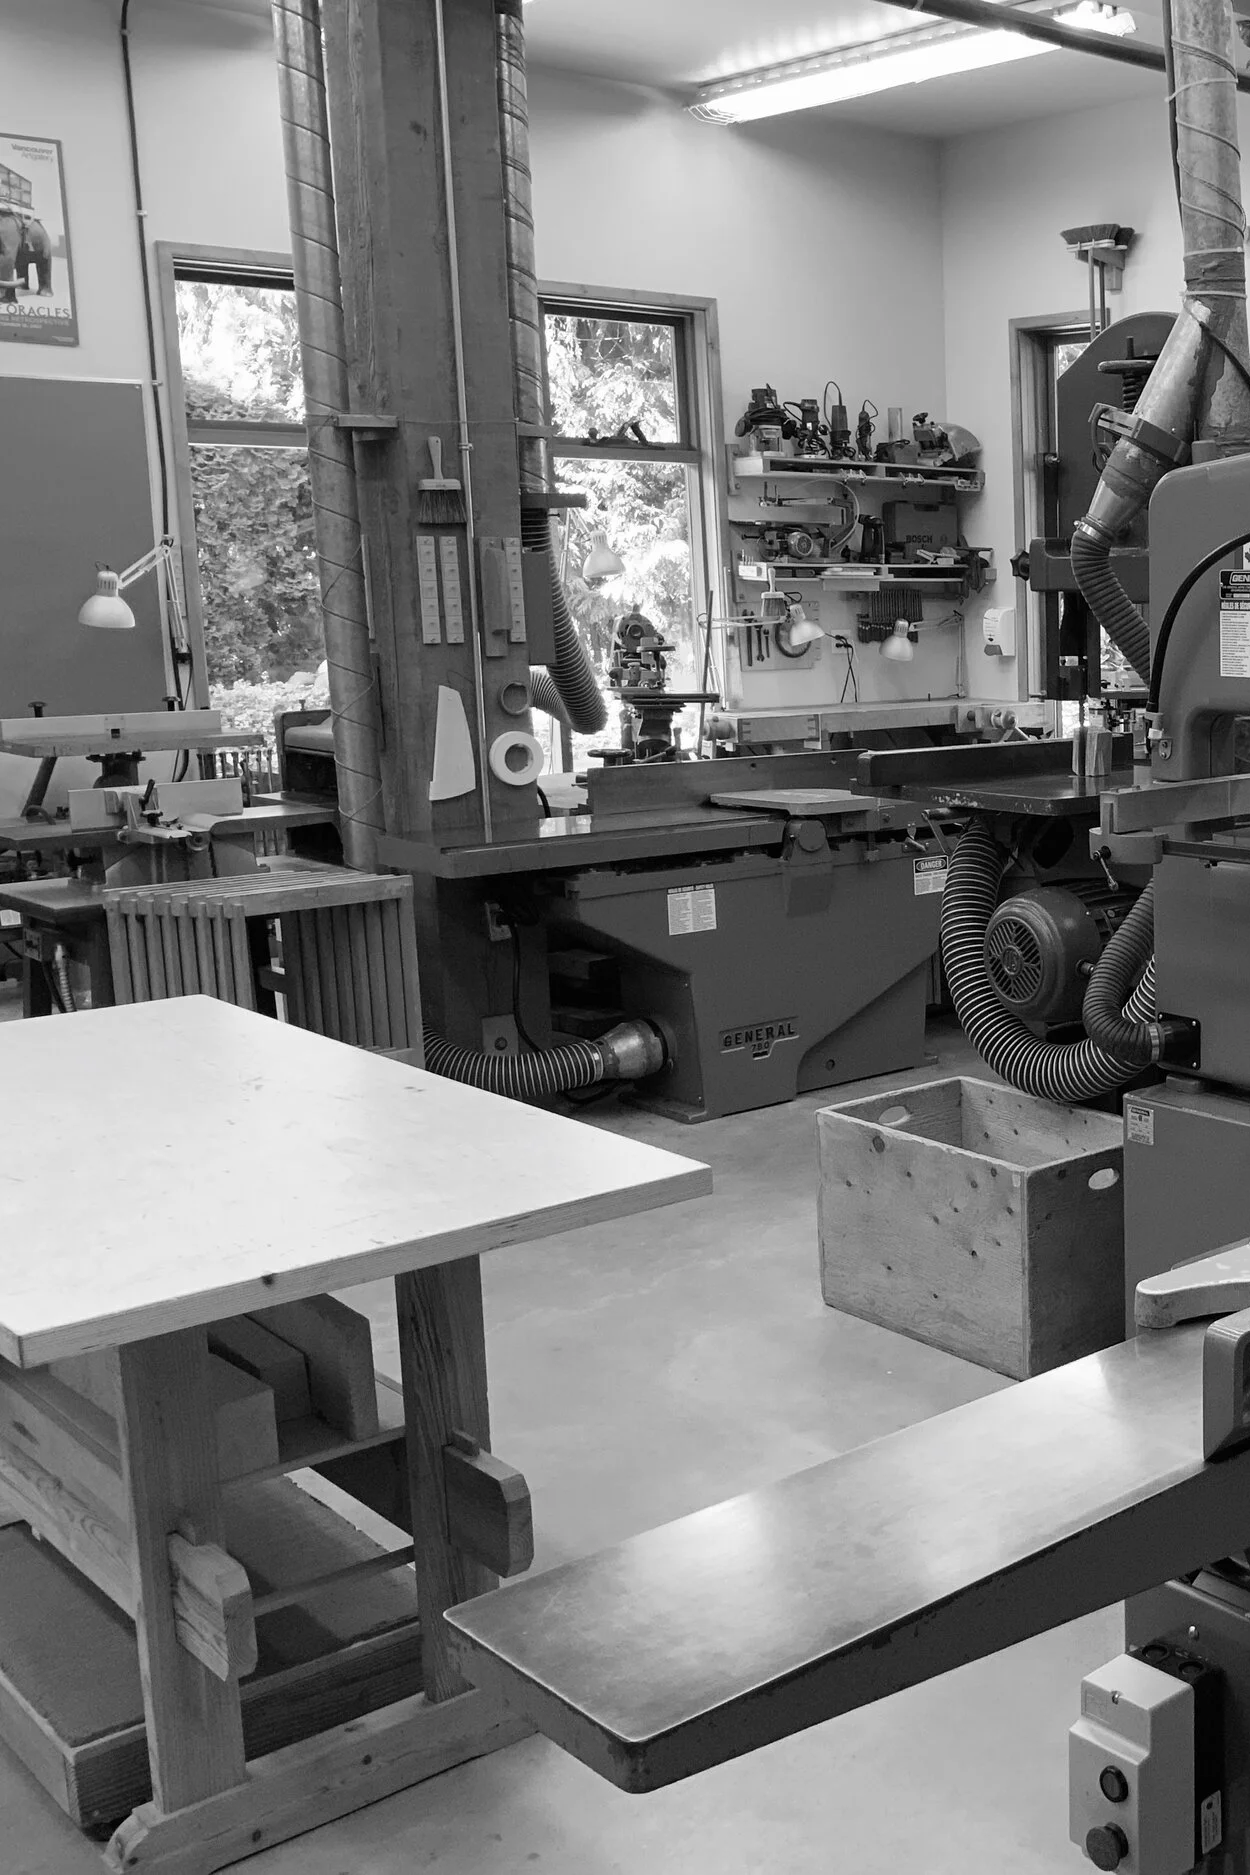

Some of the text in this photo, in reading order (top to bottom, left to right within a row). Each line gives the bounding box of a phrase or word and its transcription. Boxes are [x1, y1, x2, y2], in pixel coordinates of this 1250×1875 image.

[6, 303, 71, 320] ORACLES
[905, 535, 933, 544] BOSCH
[920, 860, 943, 870] DANGER
[723, 1022, 796, 1048] GENERAL
